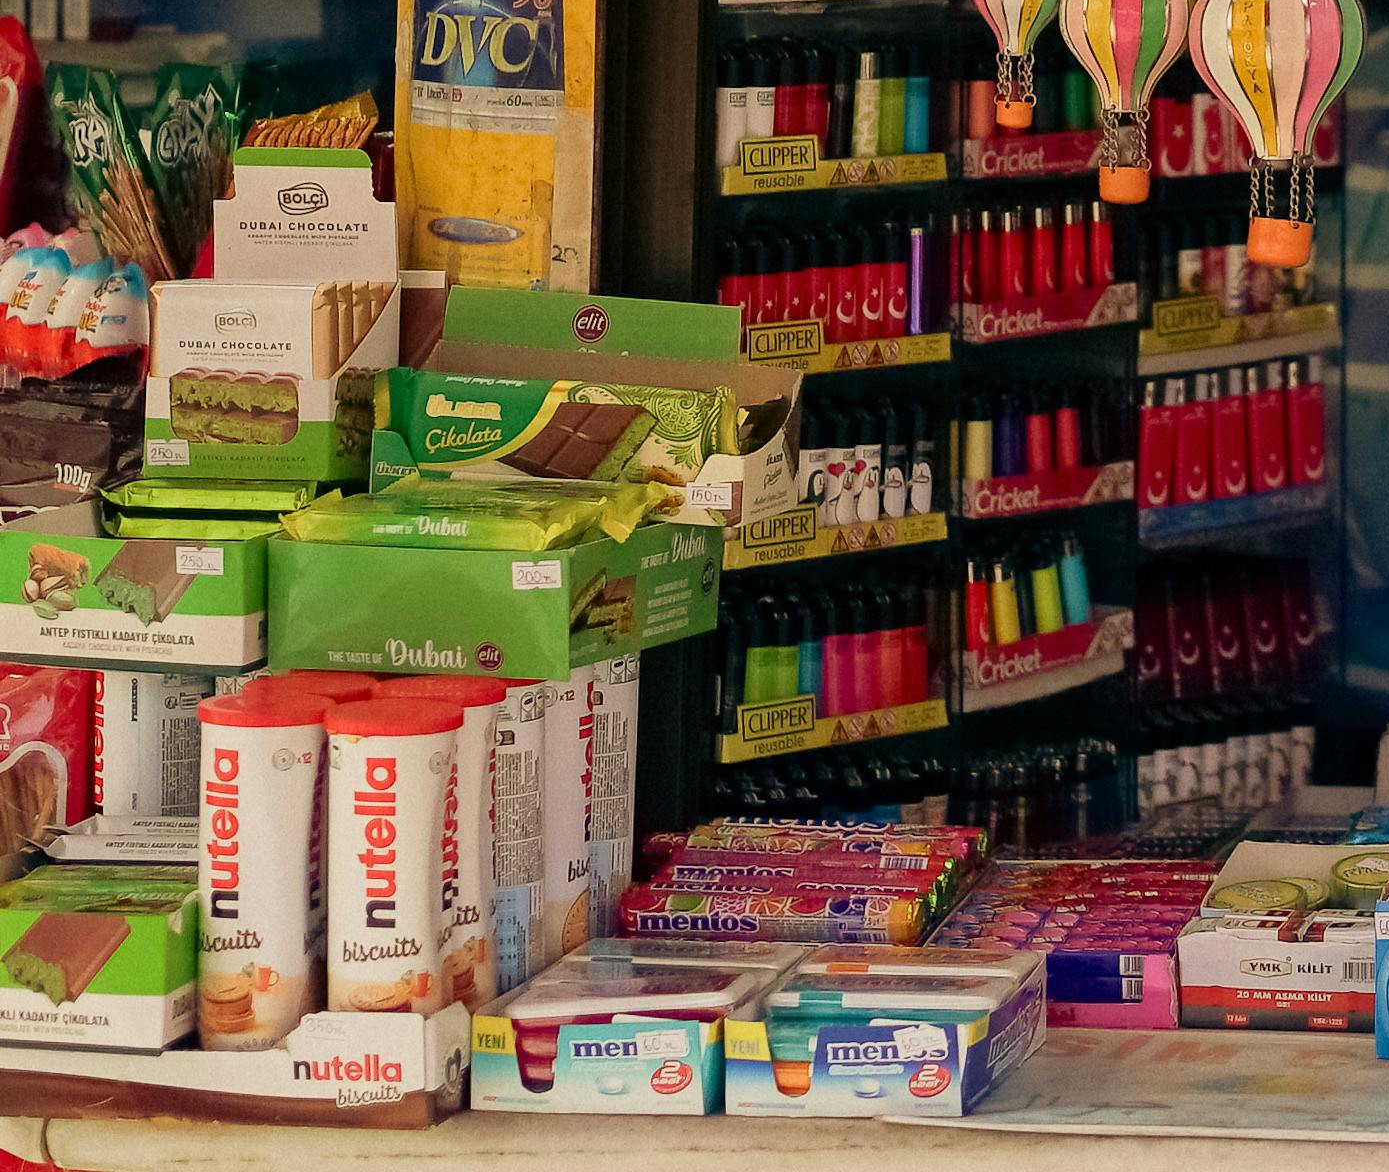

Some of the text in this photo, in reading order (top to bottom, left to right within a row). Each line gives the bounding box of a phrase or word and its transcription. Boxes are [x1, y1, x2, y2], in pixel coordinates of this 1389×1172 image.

[420, 10, 540, 78] DVC
[749, 144, 810, 168] CLIPPER
[981, 147, 1046, 174] Cricket
[753, 173, 806, 189] reusable
[238, 221, 370, 232] DUBAI CHOCOLATE
[576, 312, 605, 332] elit
[979, 308, 1044, 337] Cricket
[178, 340, 293, 351] DUBAI CHOCOLATE
[754, 330, 815, 354] CLIPPER
[426, 394, 502, 421] ÜLKER
[425, 425, 502, 454] Çikolata
[54, 463, 92, 493] 100g
[975, 486, 1040, 515] Cricket
[749, 517, 810, 541] CLIPPER
[753, 544, 806, 562] reusable
[40, 626, 70, 638] ANTEP
[112, 629, 149, 643] KADAYIF
[385, 637, 468, 670] Dubai
[478, 645, 501, 663] elit
[978, 650, 1042, 684] Cricket
[748, 709, 809, 733] CLIPPER
[753, 735, 806, 754] reusable
[206, 748, 240, 921] nutella
[353, 756, 398, 929] nutella
[638, 910, 760, 933] mentos
[341, 937, 424, 964] biscuits
[1249, 961, 1334, 975] YMK KİLİT
[1274, 991, 1305, 1001] ASMA
[476, 1032, 507, 1050] YENİ
[292, 1054, 403, 1083] nutella
[918, 1063, 939, 1082] 2
[335, 1086, 402, 1107] biscuits
